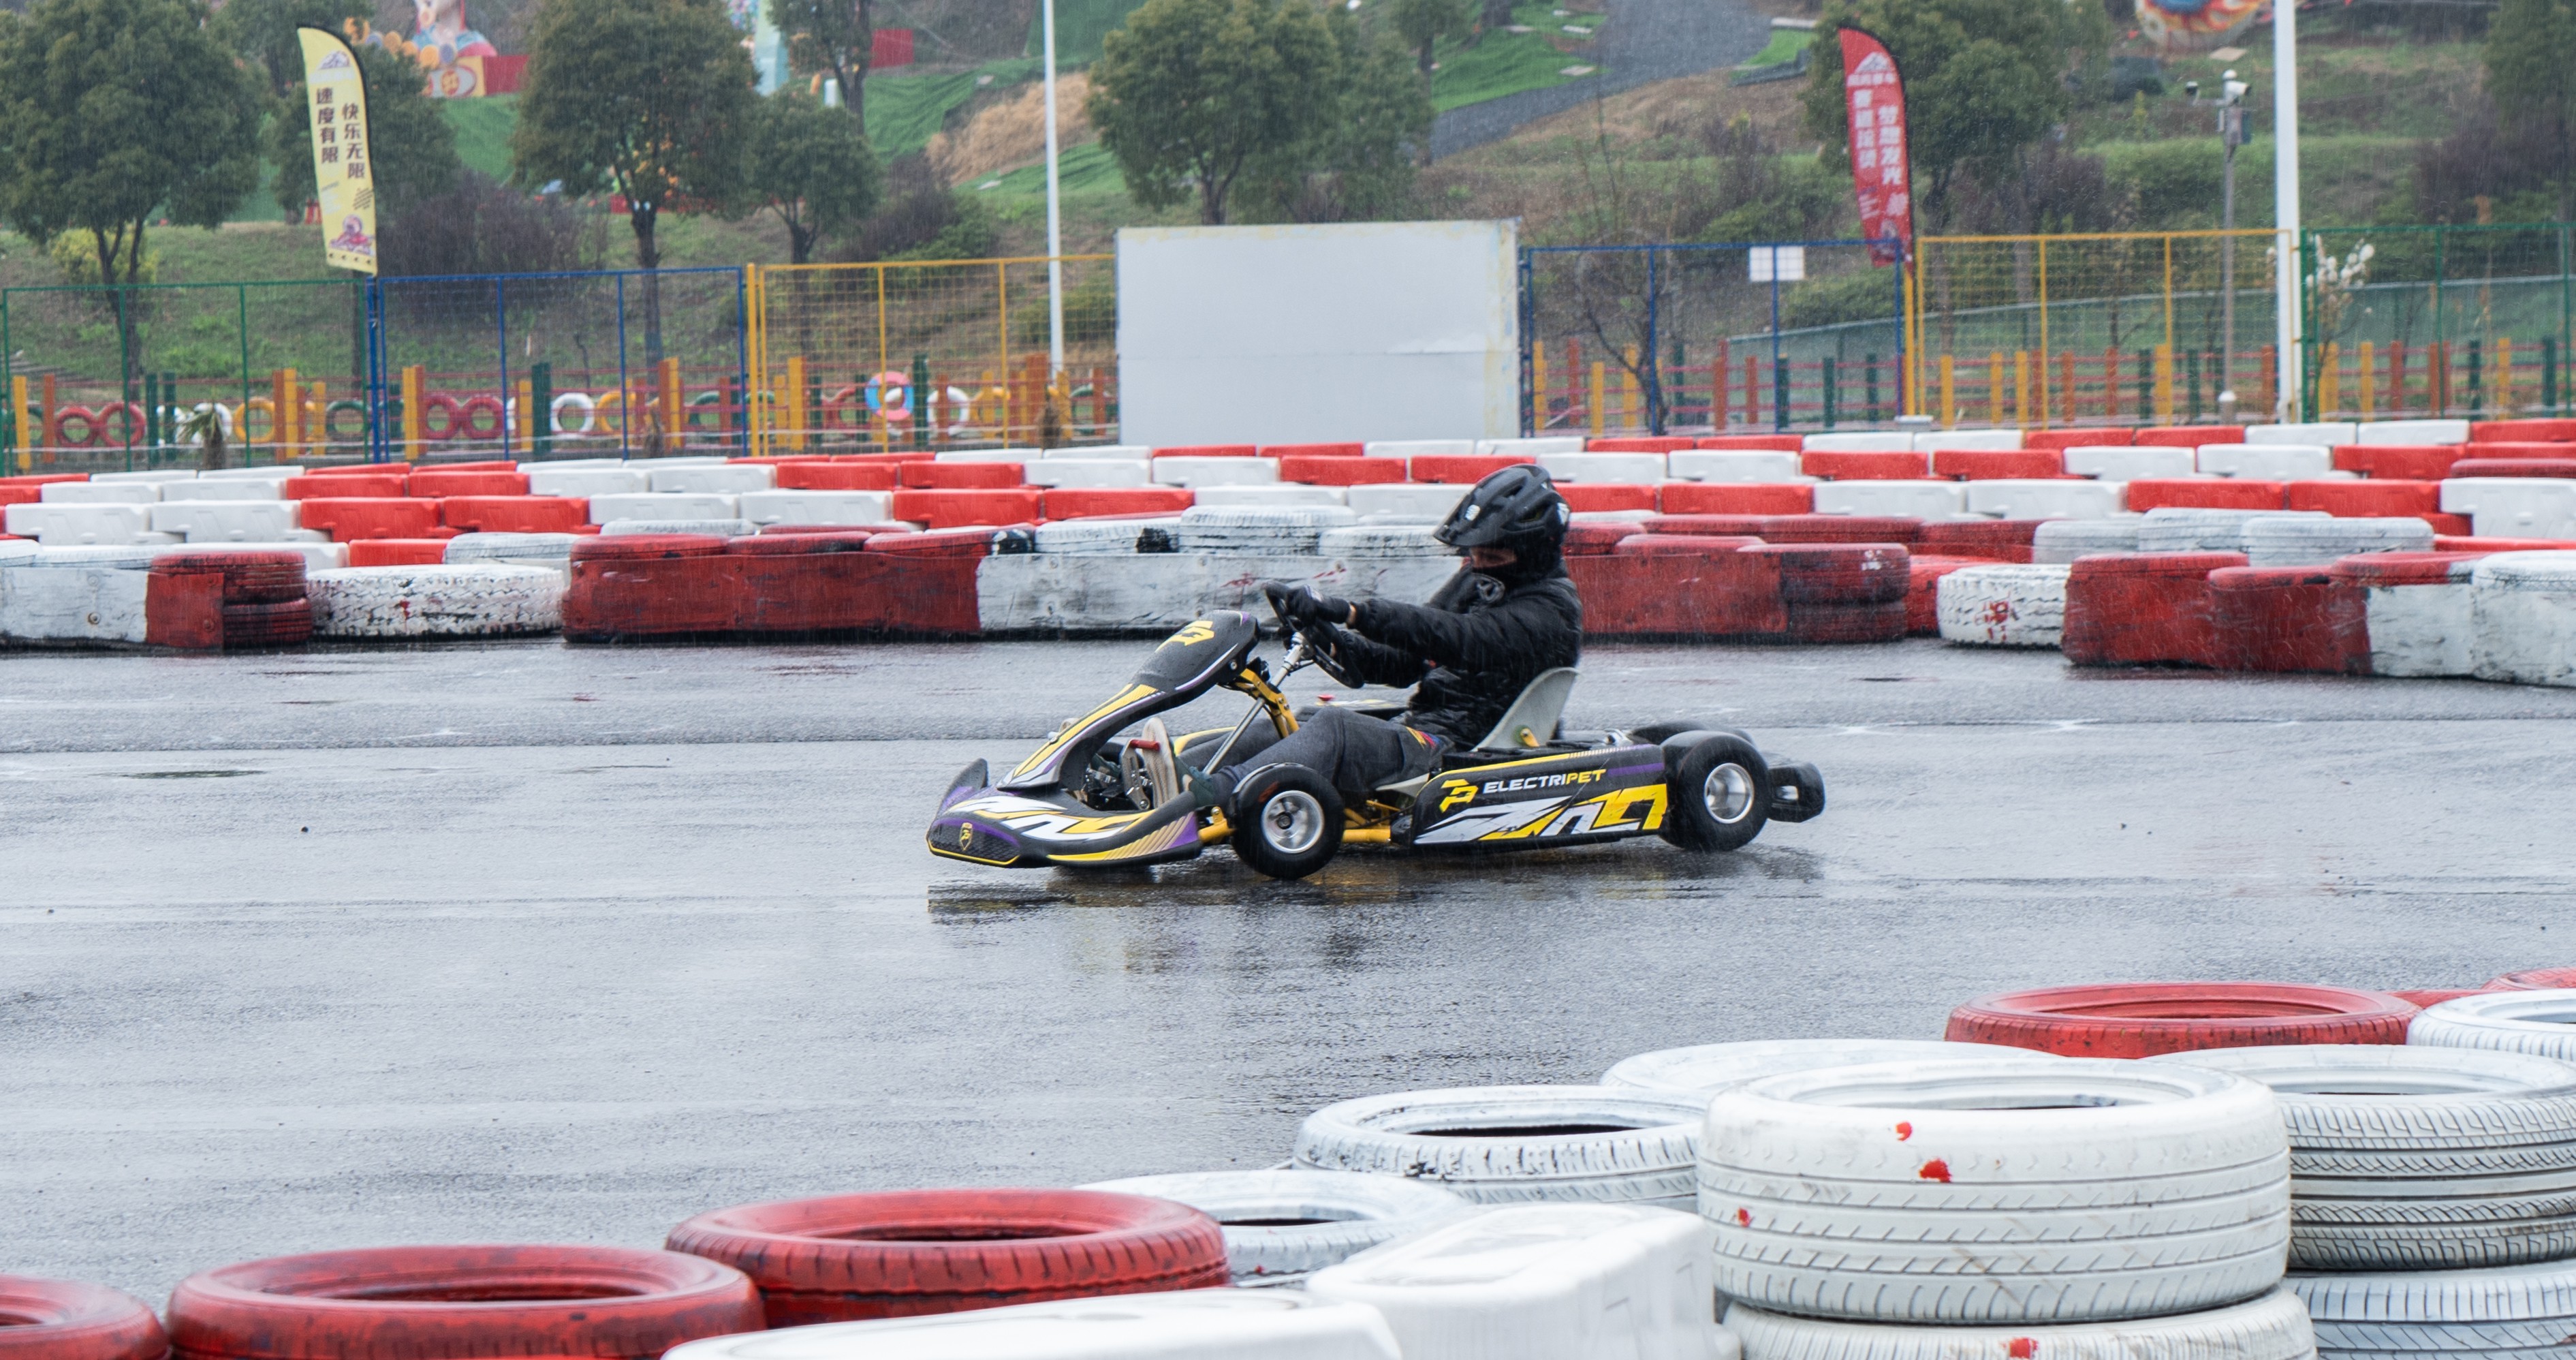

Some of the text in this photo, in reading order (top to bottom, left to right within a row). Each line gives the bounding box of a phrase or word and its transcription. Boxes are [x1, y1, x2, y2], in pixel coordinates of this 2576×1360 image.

[316, 87, 339, 164] 速度有限
[342, 103, 366, 179] 快乐无限
[1483, 769, 1607, 794] ELECTRIPET
